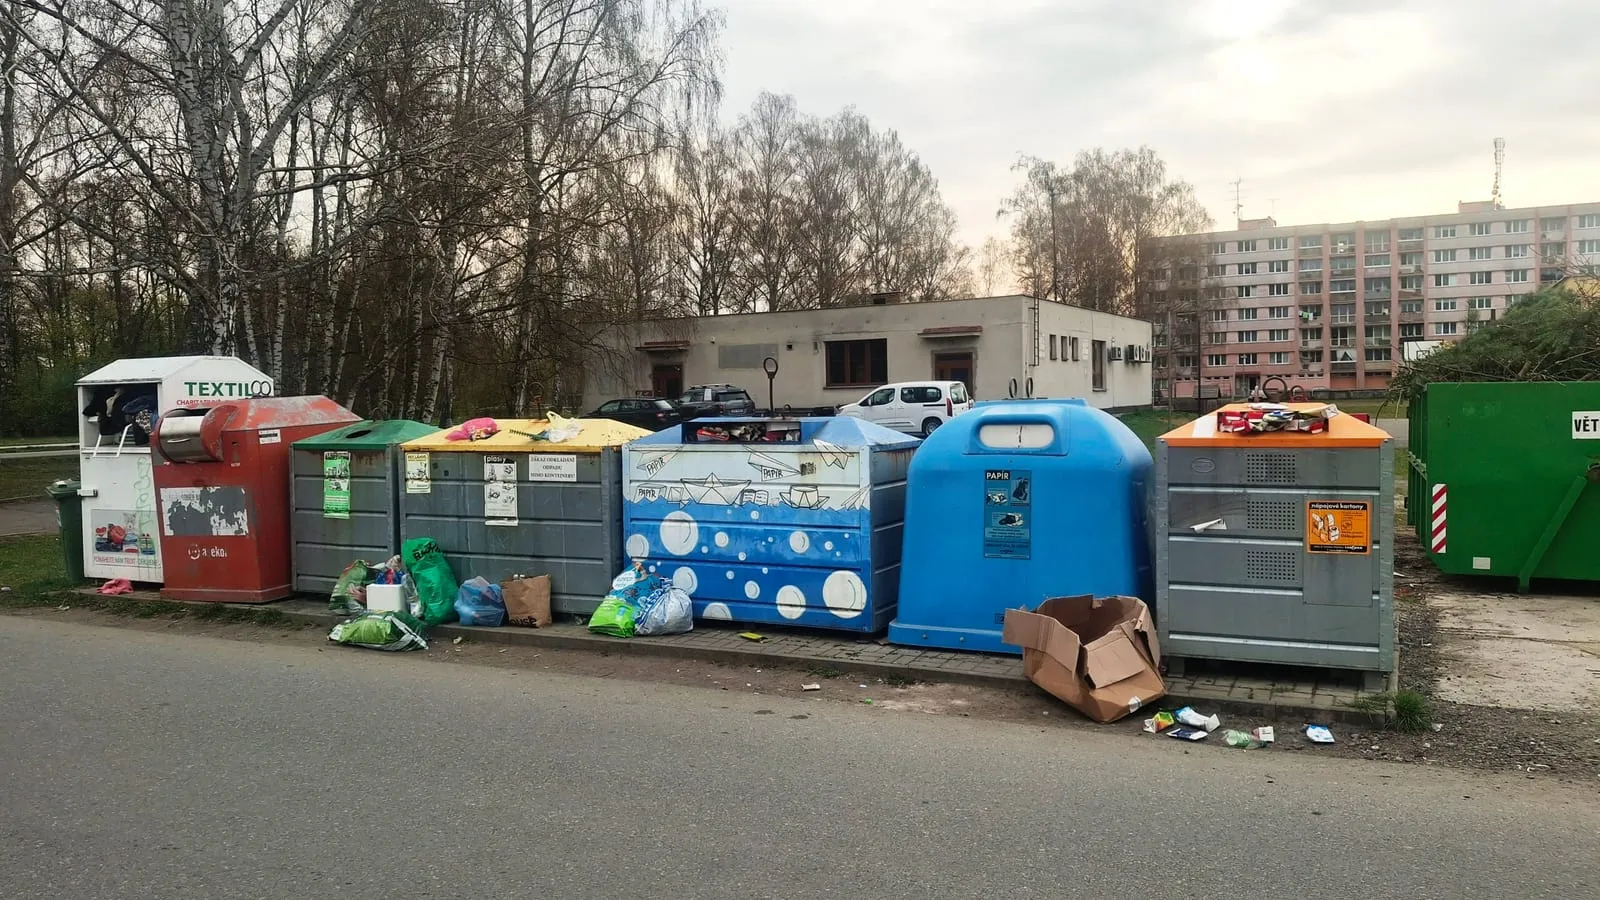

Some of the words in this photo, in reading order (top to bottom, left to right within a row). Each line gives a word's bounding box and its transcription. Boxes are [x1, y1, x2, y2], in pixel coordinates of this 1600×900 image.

[184, 381, 253, 397] TEXTIL
[1574, 415, 1600, 432] VĚT
[986, 470, 1009, 480] PAPÍR
[1340, 502, 1364, 510] kartony
